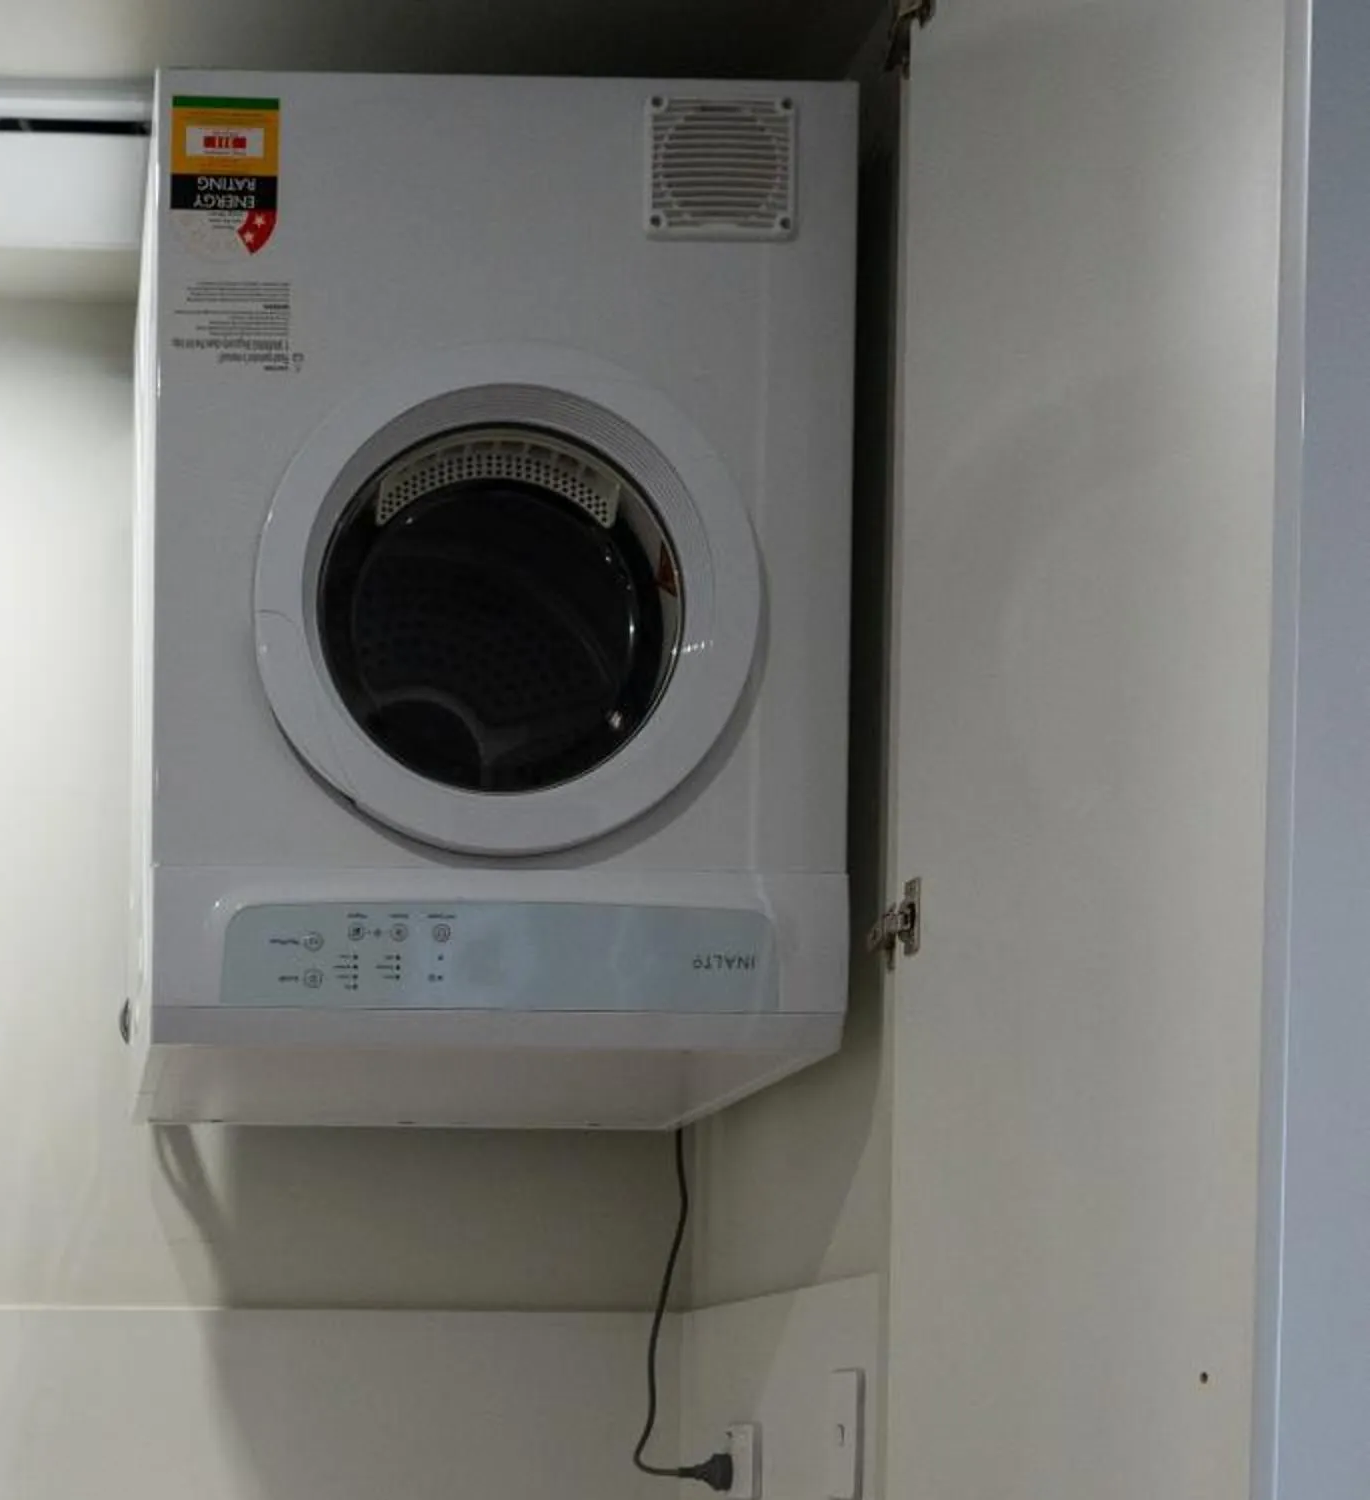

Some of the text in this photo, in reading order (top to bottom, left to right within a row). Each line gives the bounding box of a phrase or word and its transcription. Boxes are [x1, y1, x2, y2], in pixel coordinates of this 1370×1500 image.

[197, 176, 257, 191] RATING
[193, 194, 256, 208] ENERGY
[692, 954, 756, 970] INALTO
